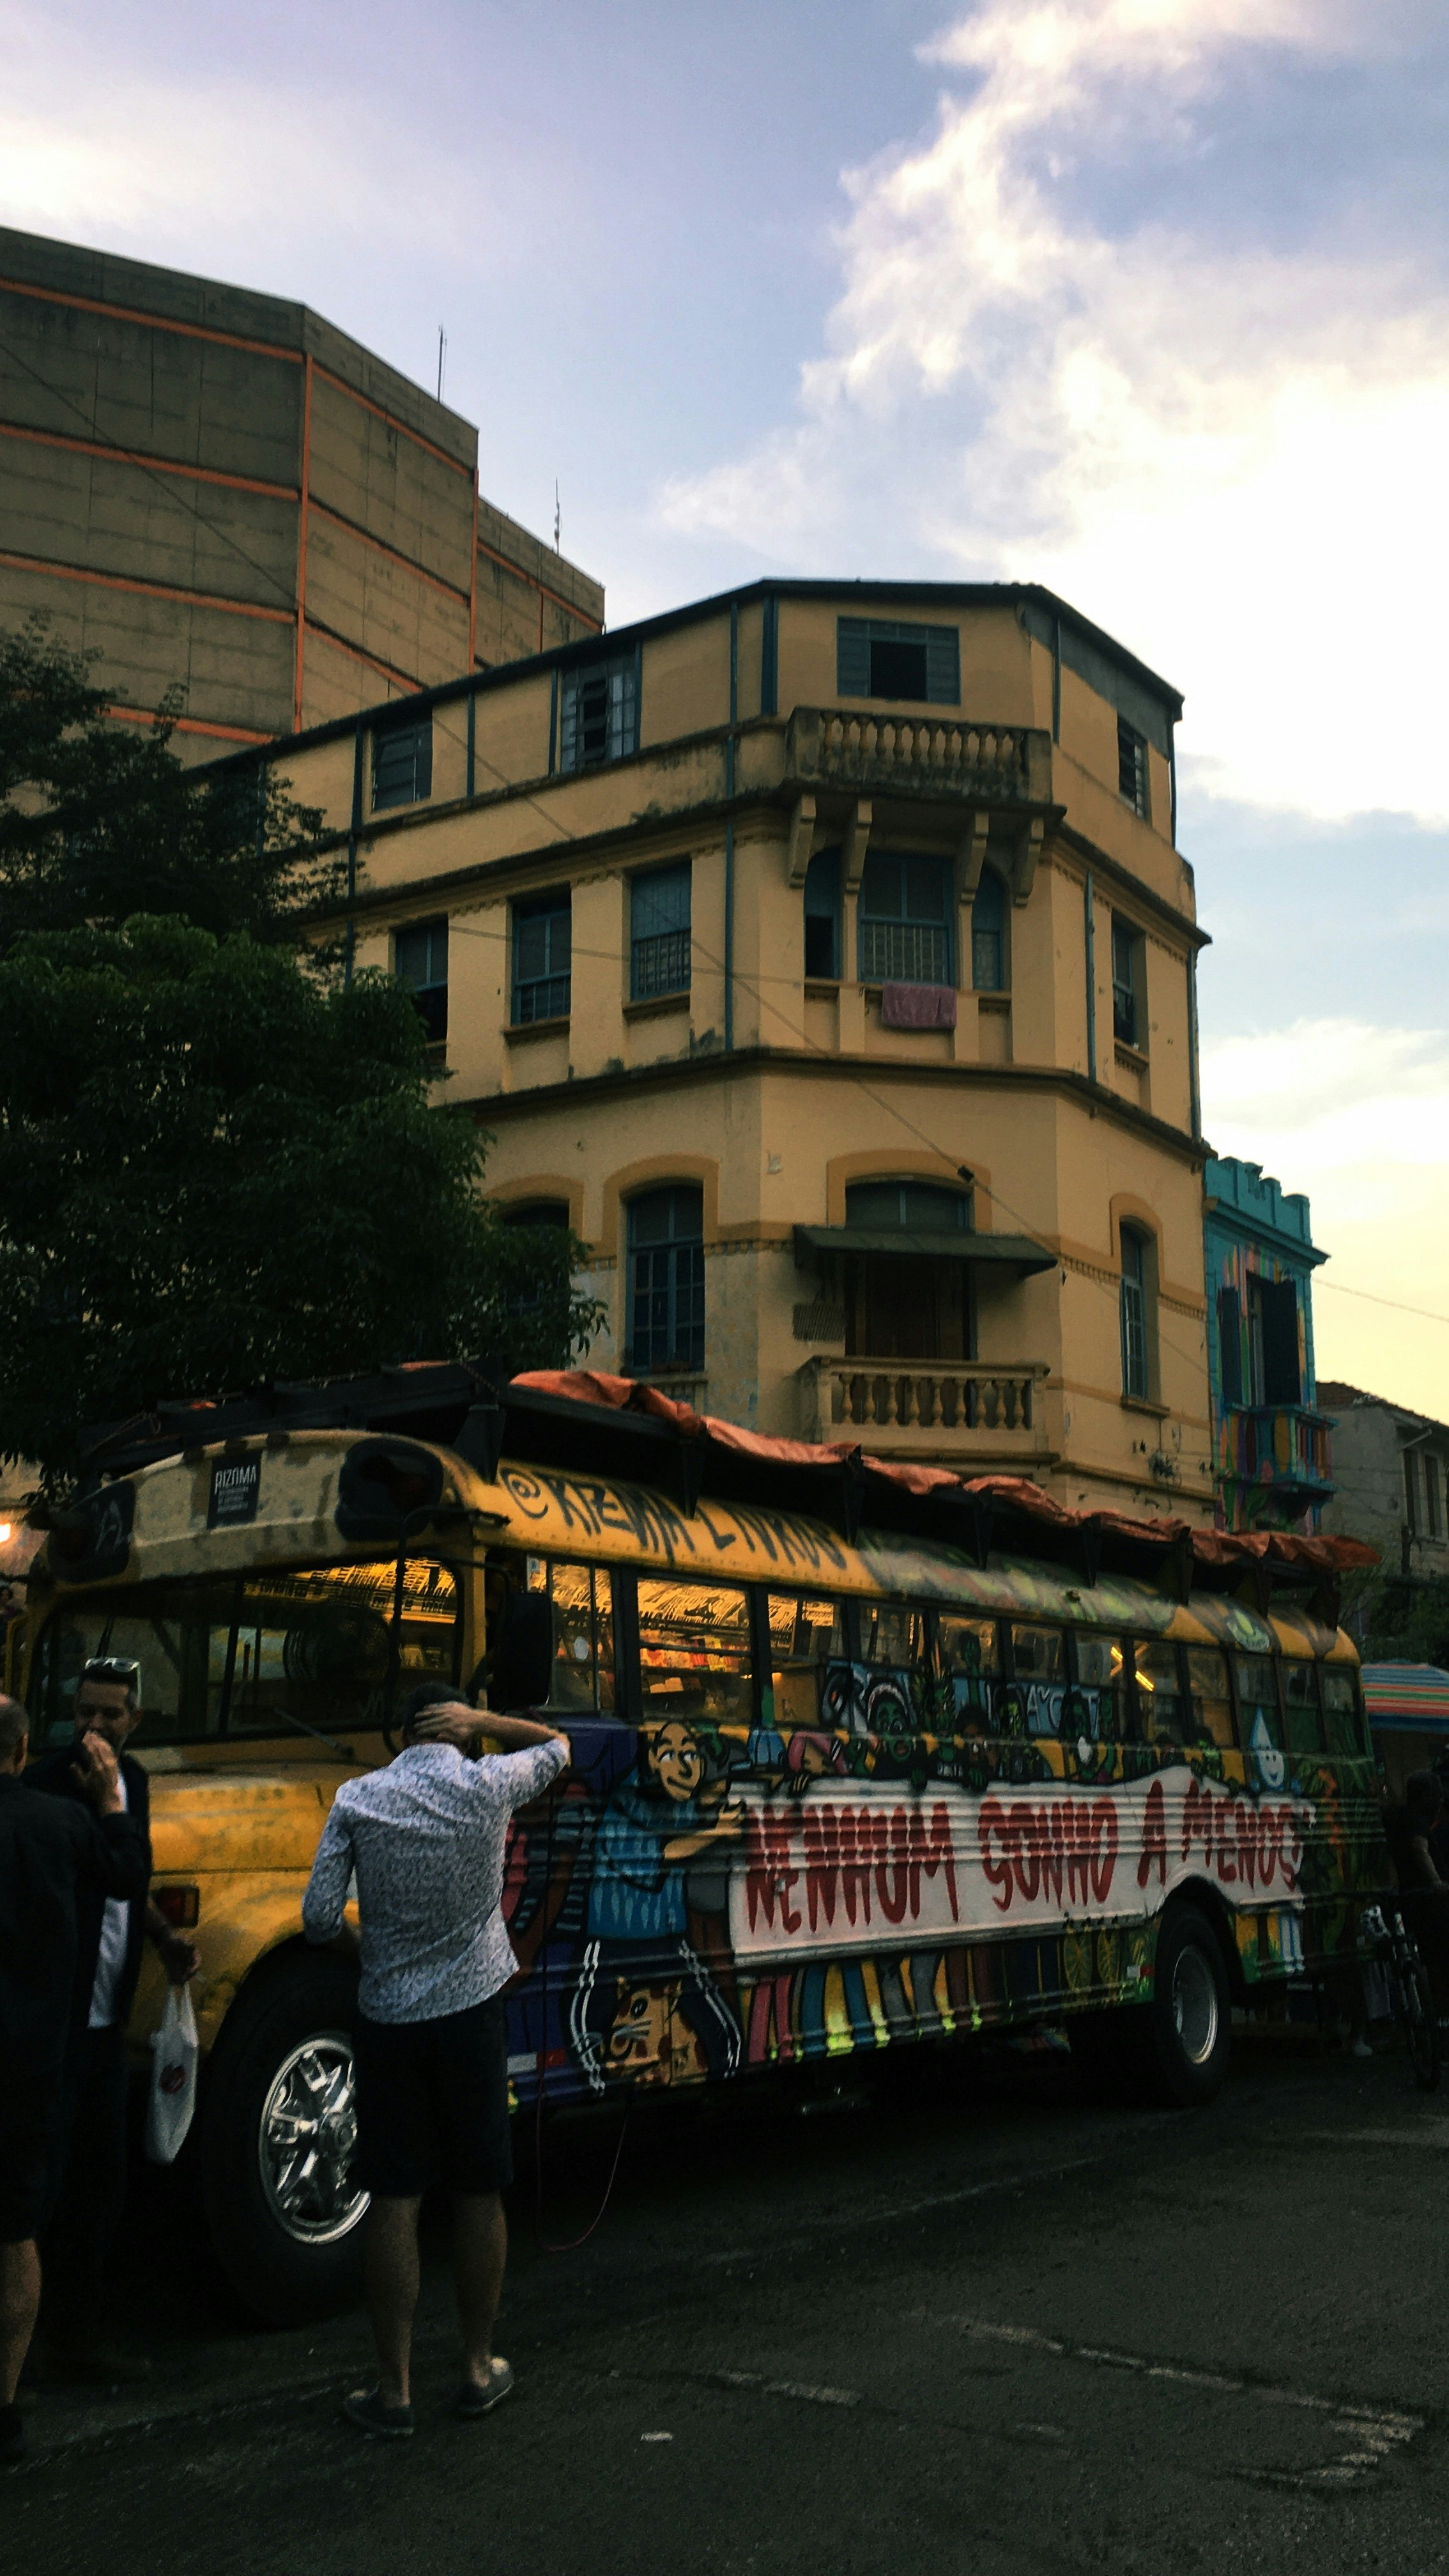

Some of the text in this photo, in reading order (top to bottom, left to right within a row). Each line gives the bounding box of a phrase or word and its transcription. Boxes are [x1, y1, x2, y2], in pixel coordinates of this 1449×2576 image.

[214, 1464, 257, 1496] RIZOMA
[746, 1800, 959, 1934] NENHUM
[977, 1794, 1118, 1911] SONHO
[1138, 1779, 1166, 1889] A
